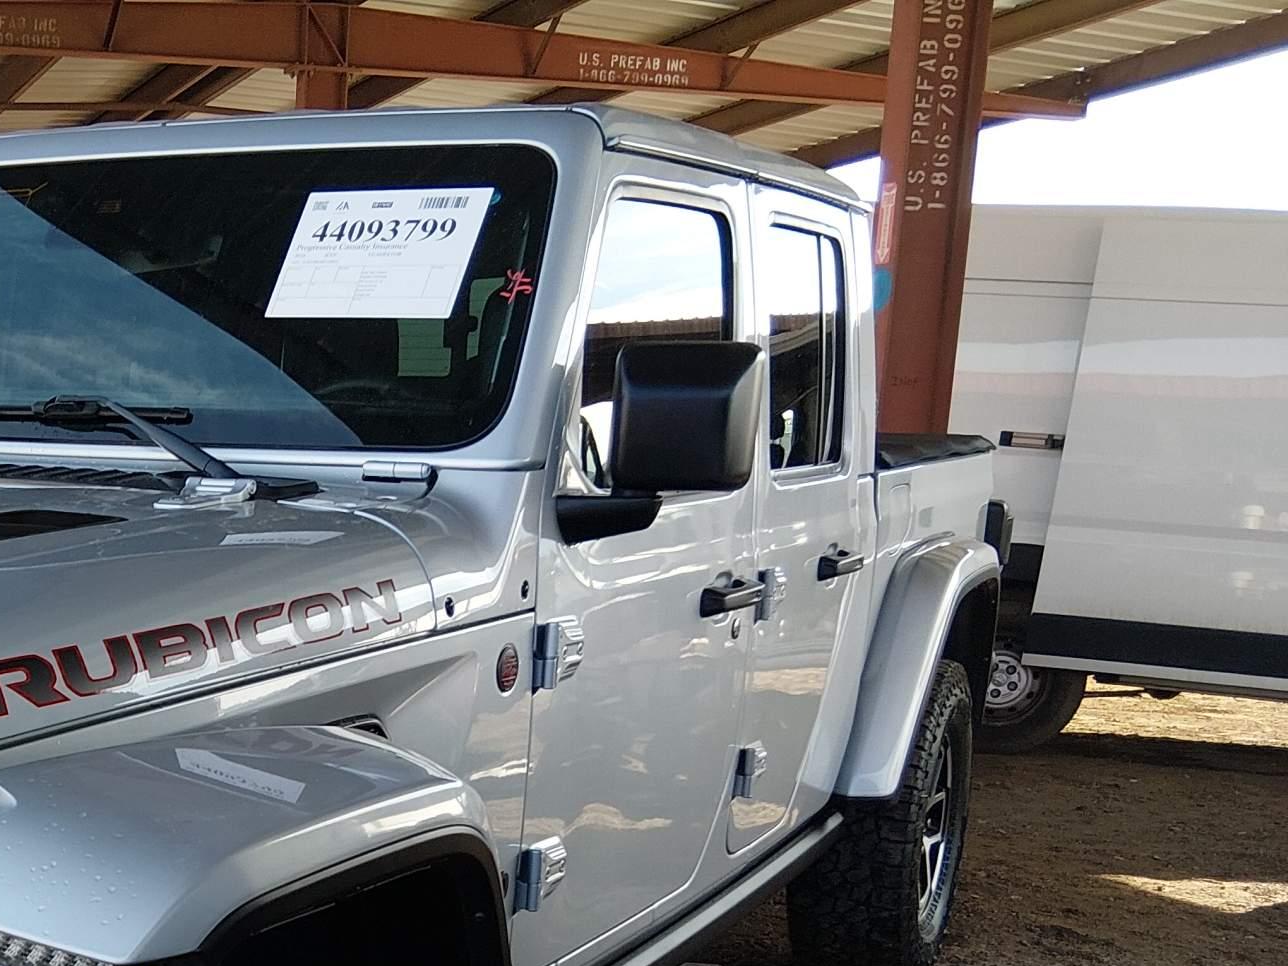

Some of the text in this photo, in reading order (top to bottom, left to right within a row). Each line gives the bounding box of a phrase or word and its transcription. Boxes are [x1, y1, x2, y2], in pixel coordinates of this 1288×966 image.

[34, 18, 57, 32] INC
[579, 52, 687, 73] U.S. PREFAB INC
[911, 39, 939, 144] PREFAB
[904, 162, 927, 210] U.S.
[312, 218, 457, 242] 44093799
